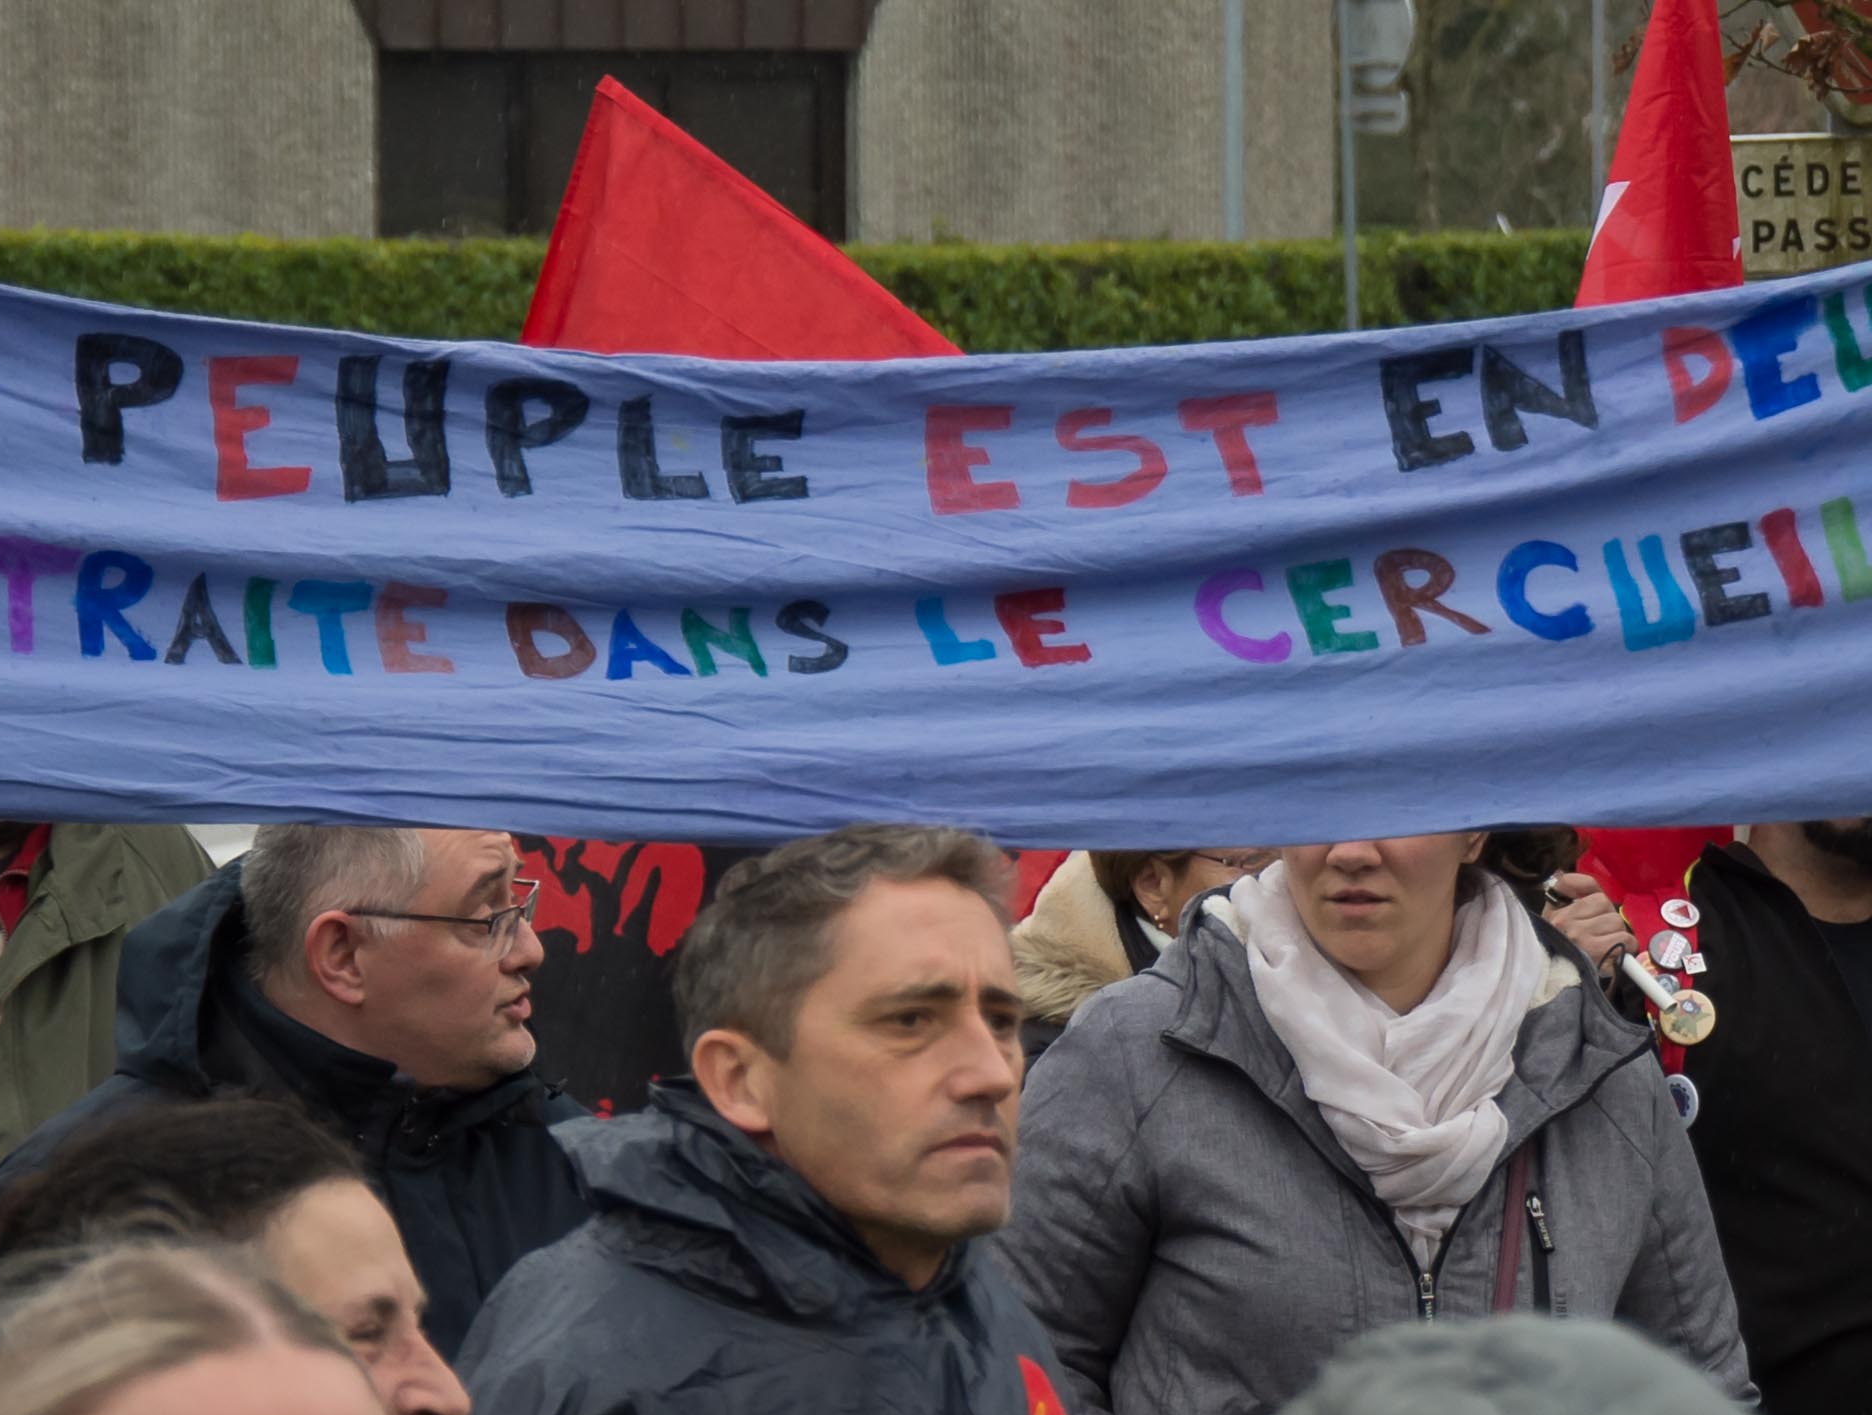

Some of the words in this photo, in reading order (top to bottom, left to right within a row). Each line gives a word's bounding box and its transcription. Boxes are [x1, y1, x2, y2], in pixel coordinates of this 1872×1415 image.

[74, 332, 809, 503] PEUPLE
[923, 391, 1281, 516] EST
[1378, 330, 1599, 473] EN
[506, 599, 850, 683] DANS
[914, 588, 1094, 669] LE
